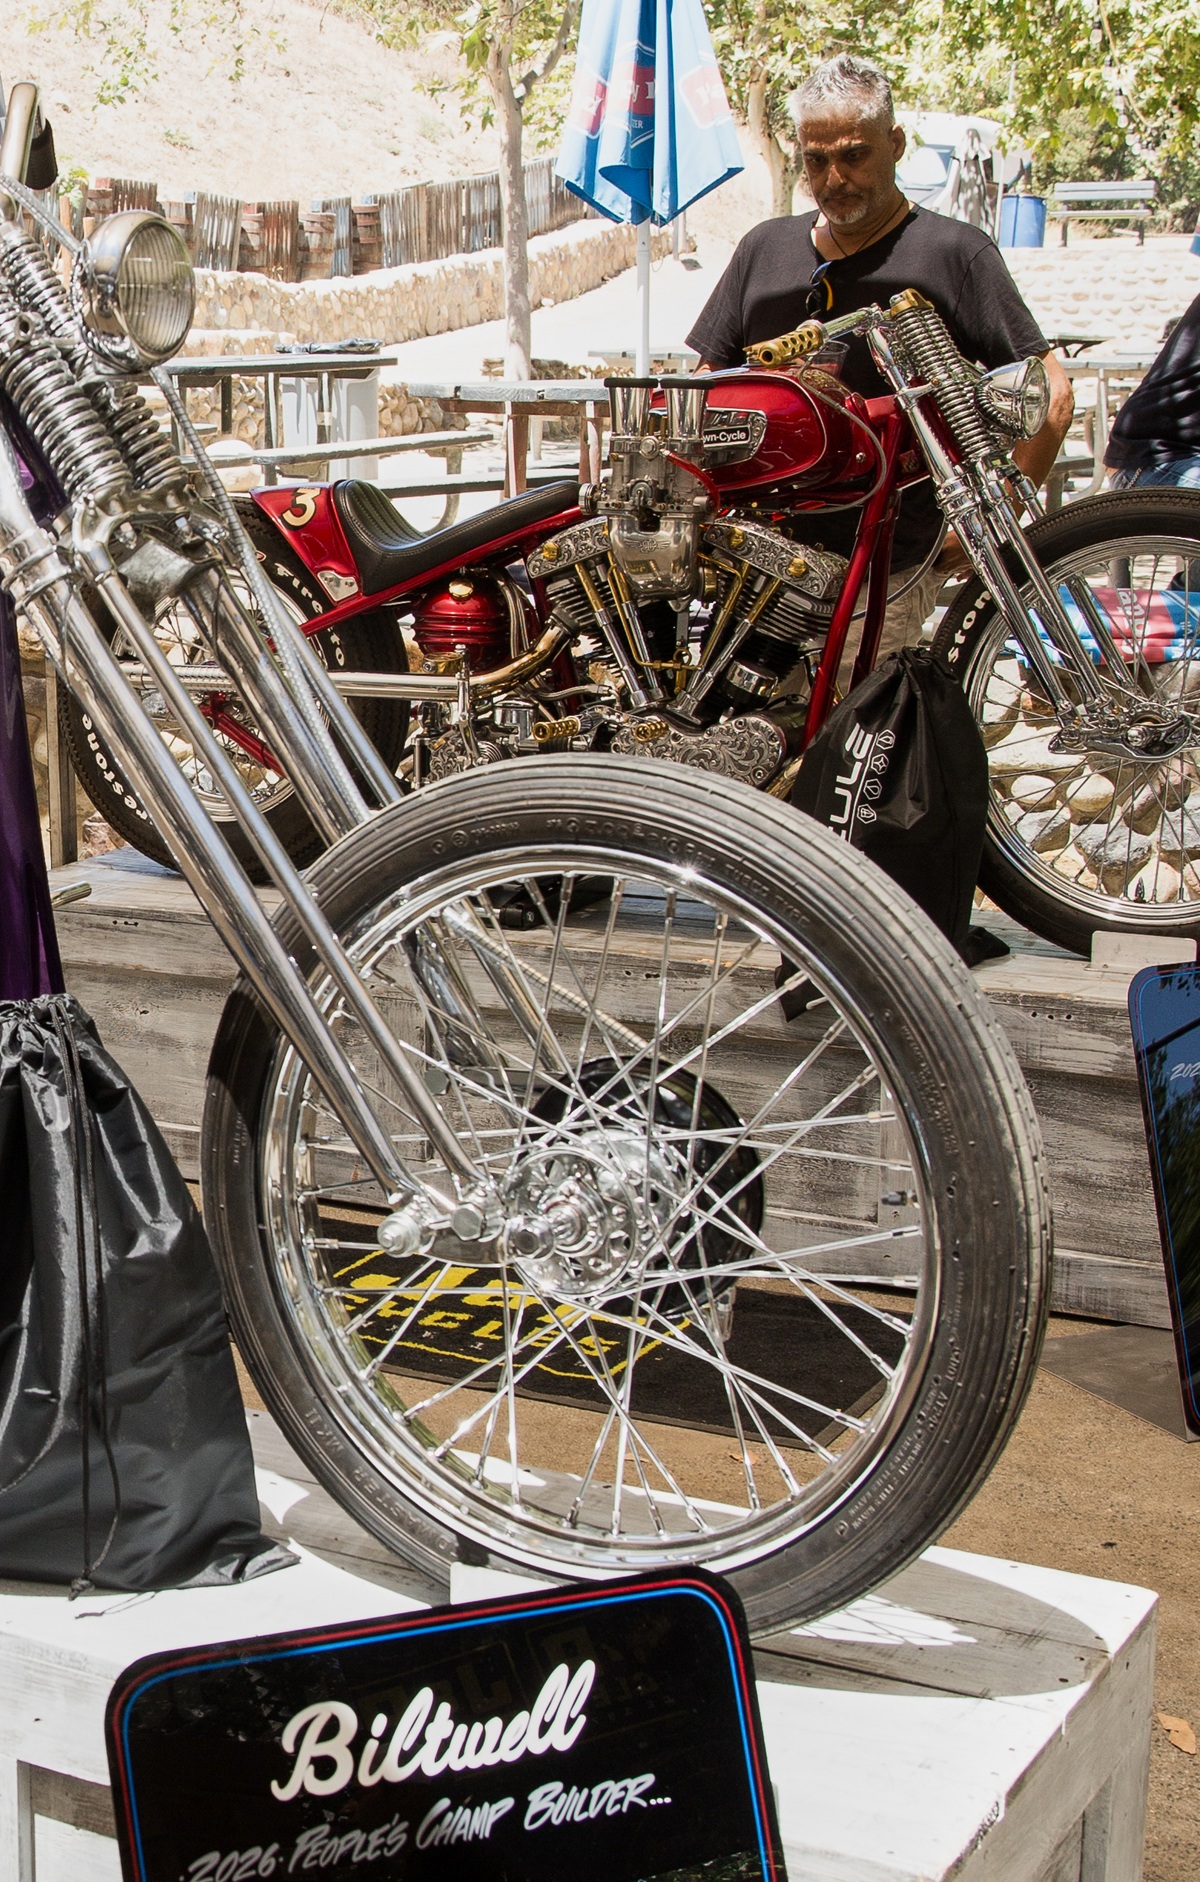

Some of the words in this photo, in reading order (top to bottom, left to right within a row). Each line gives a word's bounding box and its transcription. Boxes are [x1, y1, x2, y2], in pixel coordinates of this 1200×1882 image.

[702, 430, 746, 443] wn-Cycle
[281, 487, 322, 530] 3
[947, 590, 992, 664] ston
[82, 713, 153, 826] restone
[1170, 1061, 1200, 1081] 202
[270, 1659, 597, 1802] Biltwell
[415, 1797, 515, 1851] CHAMP
